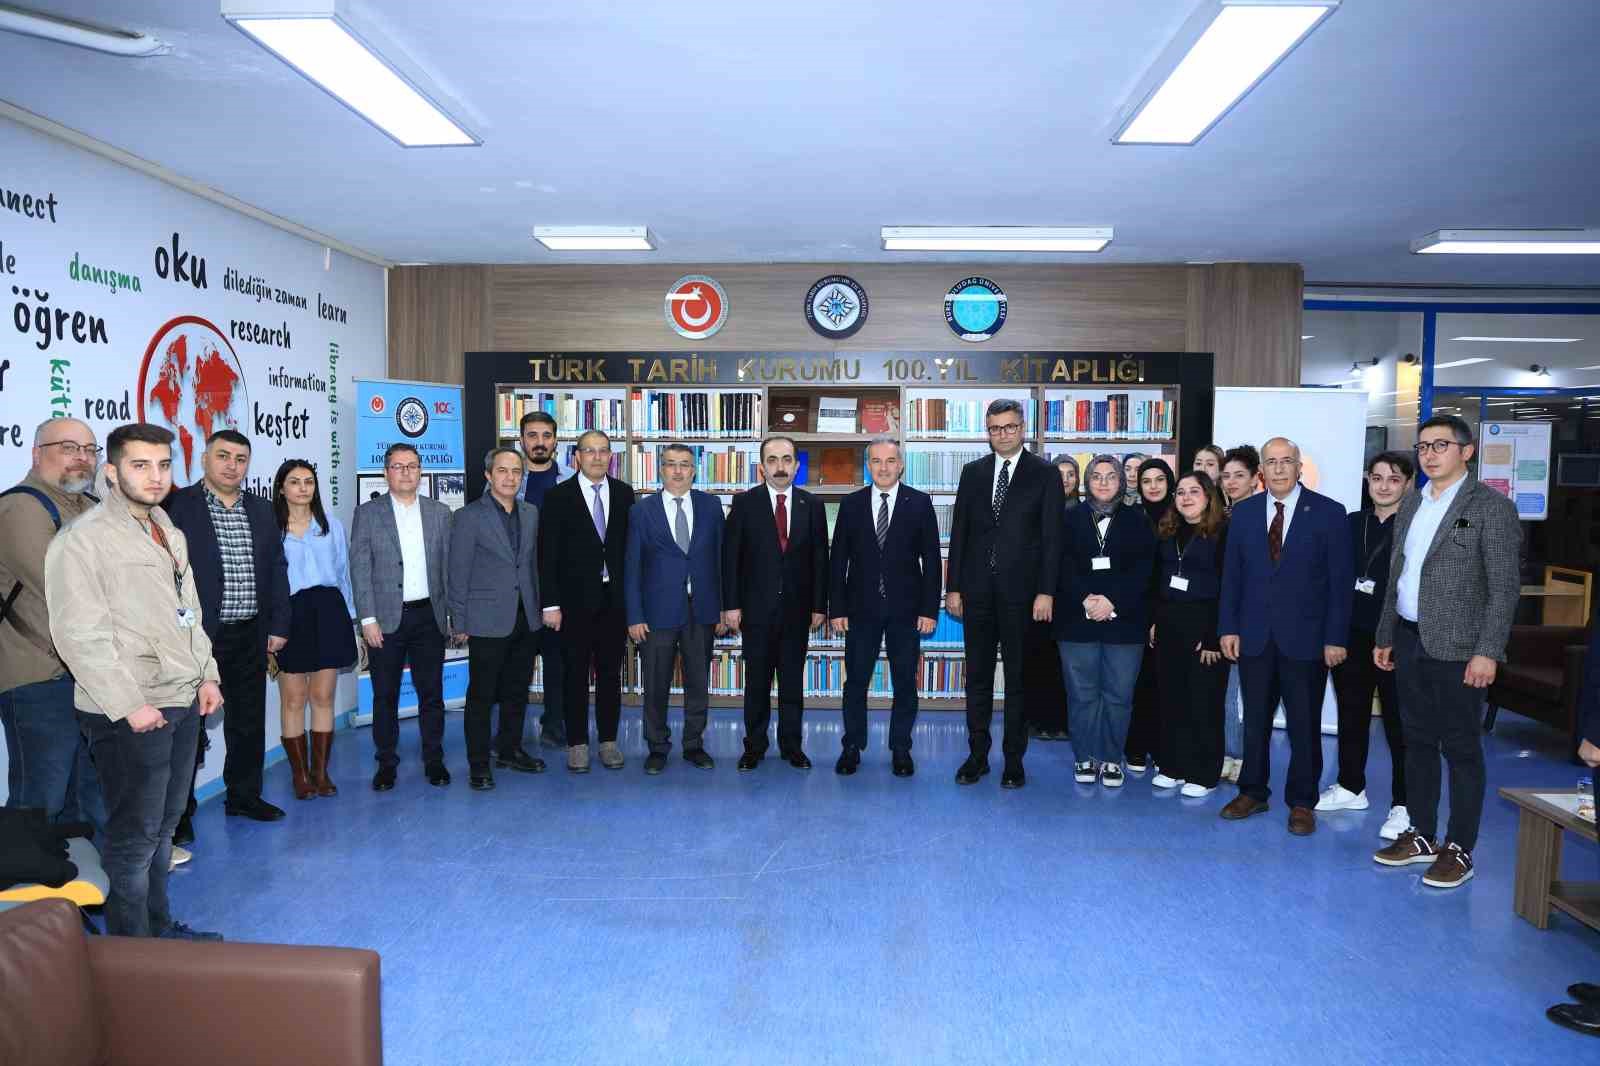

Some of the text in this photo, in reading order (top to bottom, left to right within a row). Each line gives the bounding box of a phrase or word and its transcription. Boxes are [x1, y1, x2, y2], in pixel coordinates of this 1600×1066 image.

[69, 252, 142, 294] danışma
[155, 233, 208, 289] oku
[223, 267, 308, 309] dilediğin zaman
[317, 293, 348, 324] learn
[12, 285, 109, 350] öğren
[230, 319, 291, 349] research
[268, 366, 326, 392] information
[328, 342, 339, 403] library
[528, 354, 608, 381] TÜRK
[627, 353, 717, 382] TARİH
[736, 359, 860, 381] KURUMU
[1000, 353, 1145, 382] KİTAPLIĞI
[84, 389, 131, 420] read
[254, 401, 310, 446] keşfet
